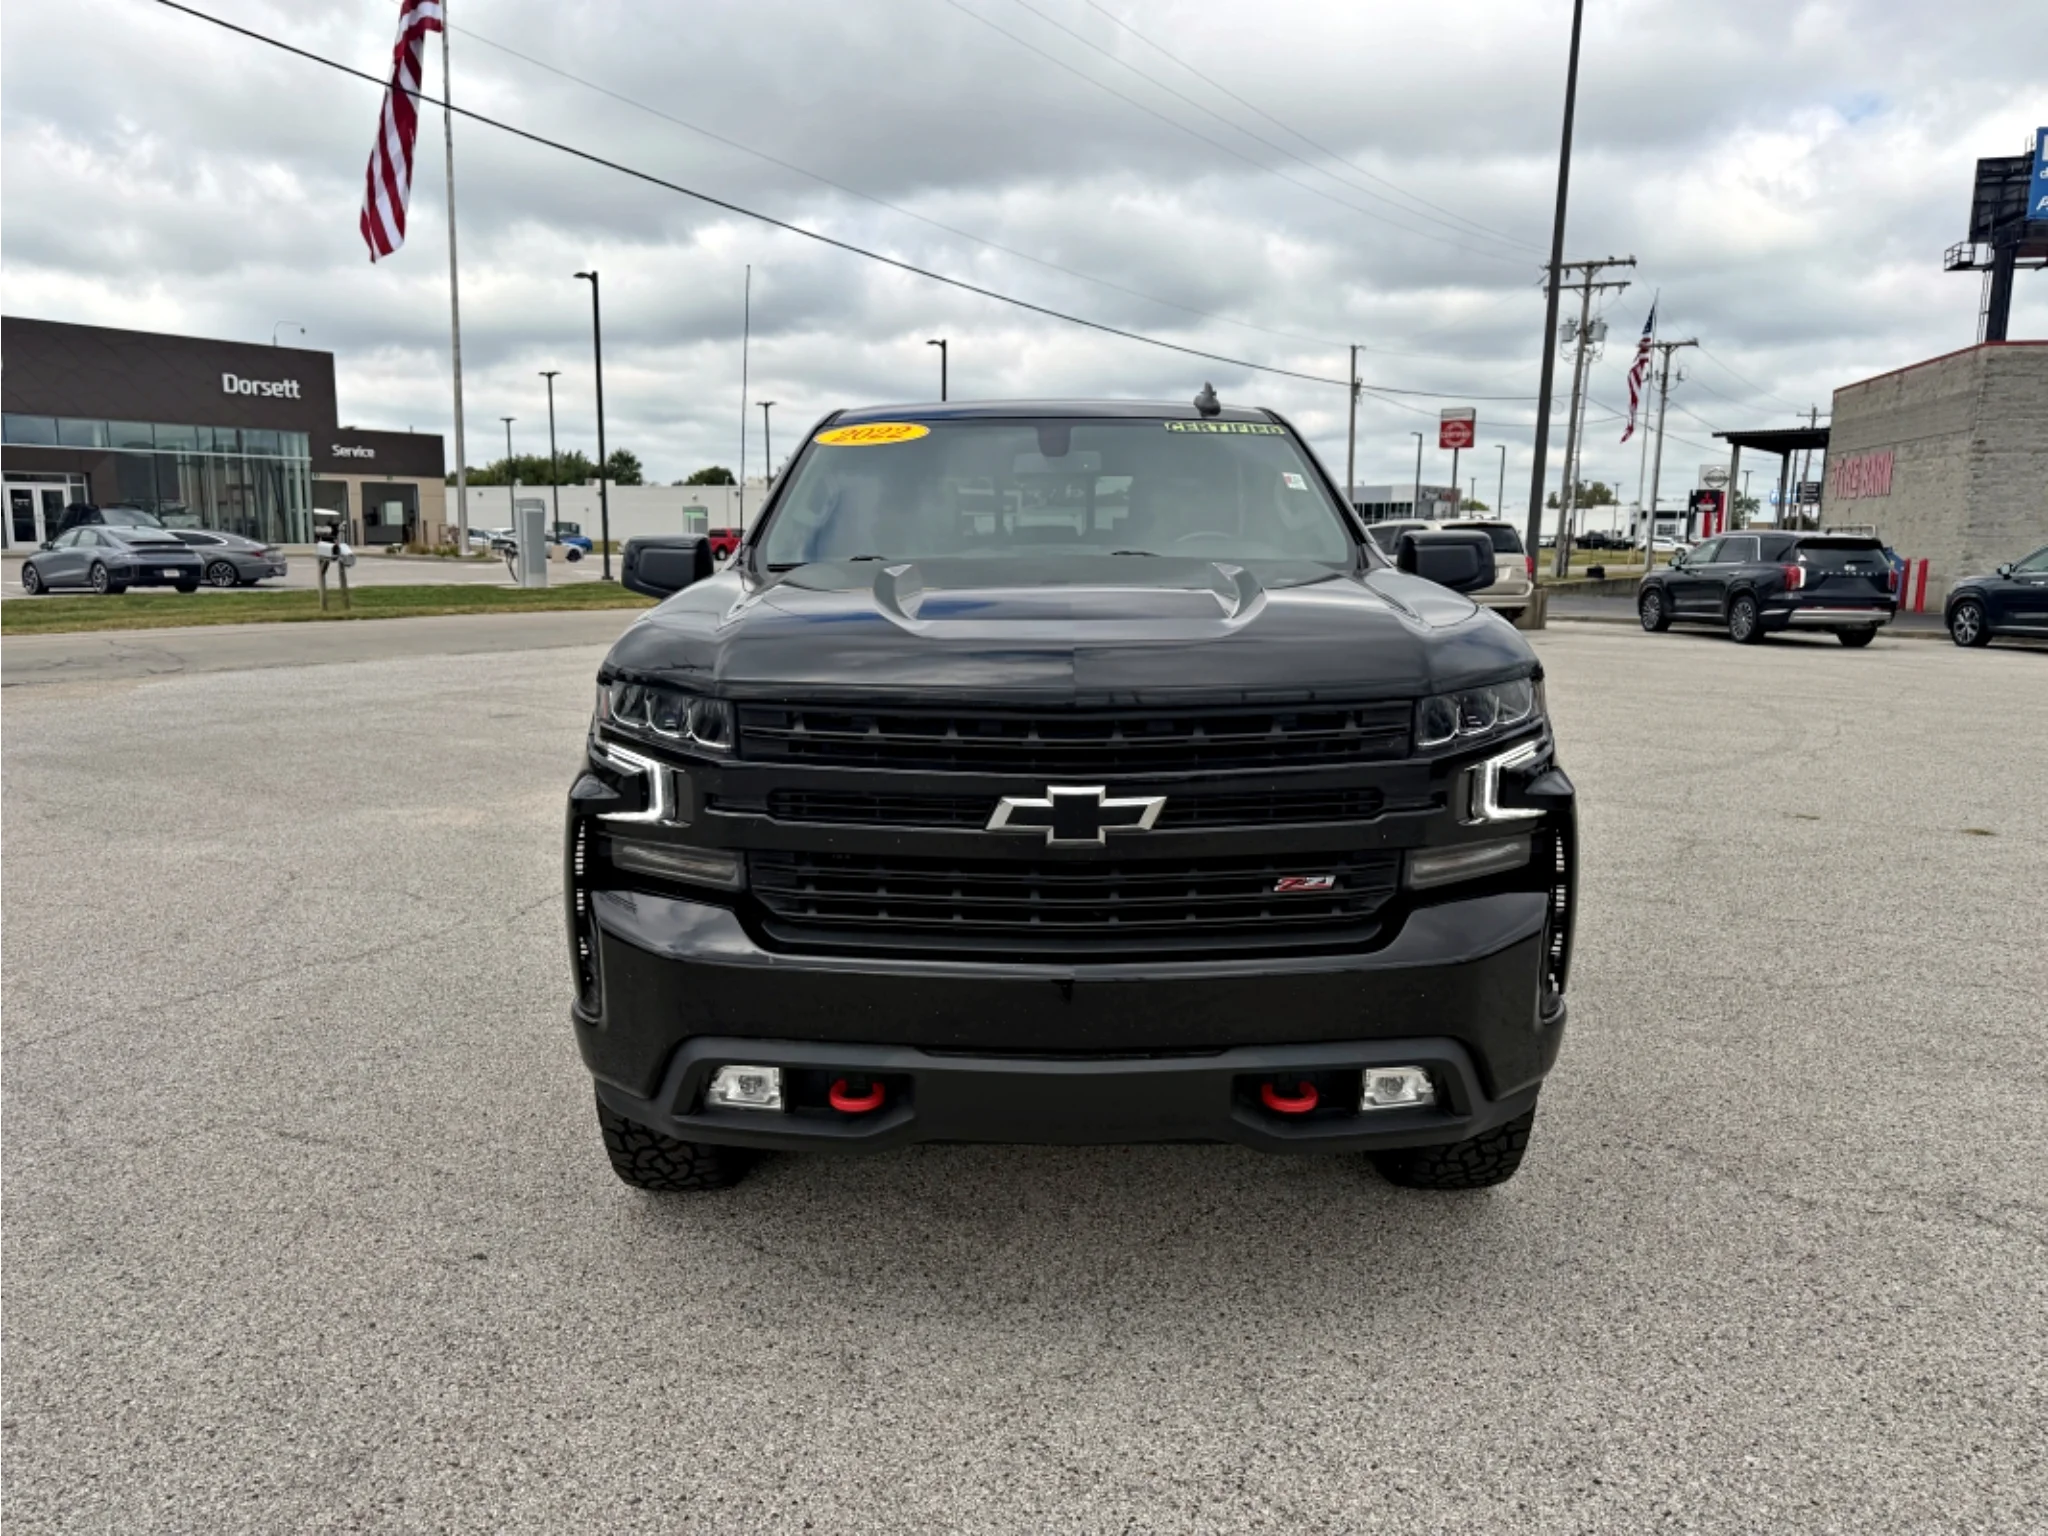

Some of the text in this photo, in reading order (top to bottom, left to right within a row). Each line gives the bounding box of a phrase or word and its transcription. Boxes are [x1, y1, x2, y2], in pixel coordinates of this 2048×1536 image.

[222, 372, 301, 399] Dorsett
[831, 425, 912, 442] 2022
[1164, 421, 1285, 435] CERTIFIED
[331, 443, 375, 459] Service
[1860, 450, 1894, 497] BARN
